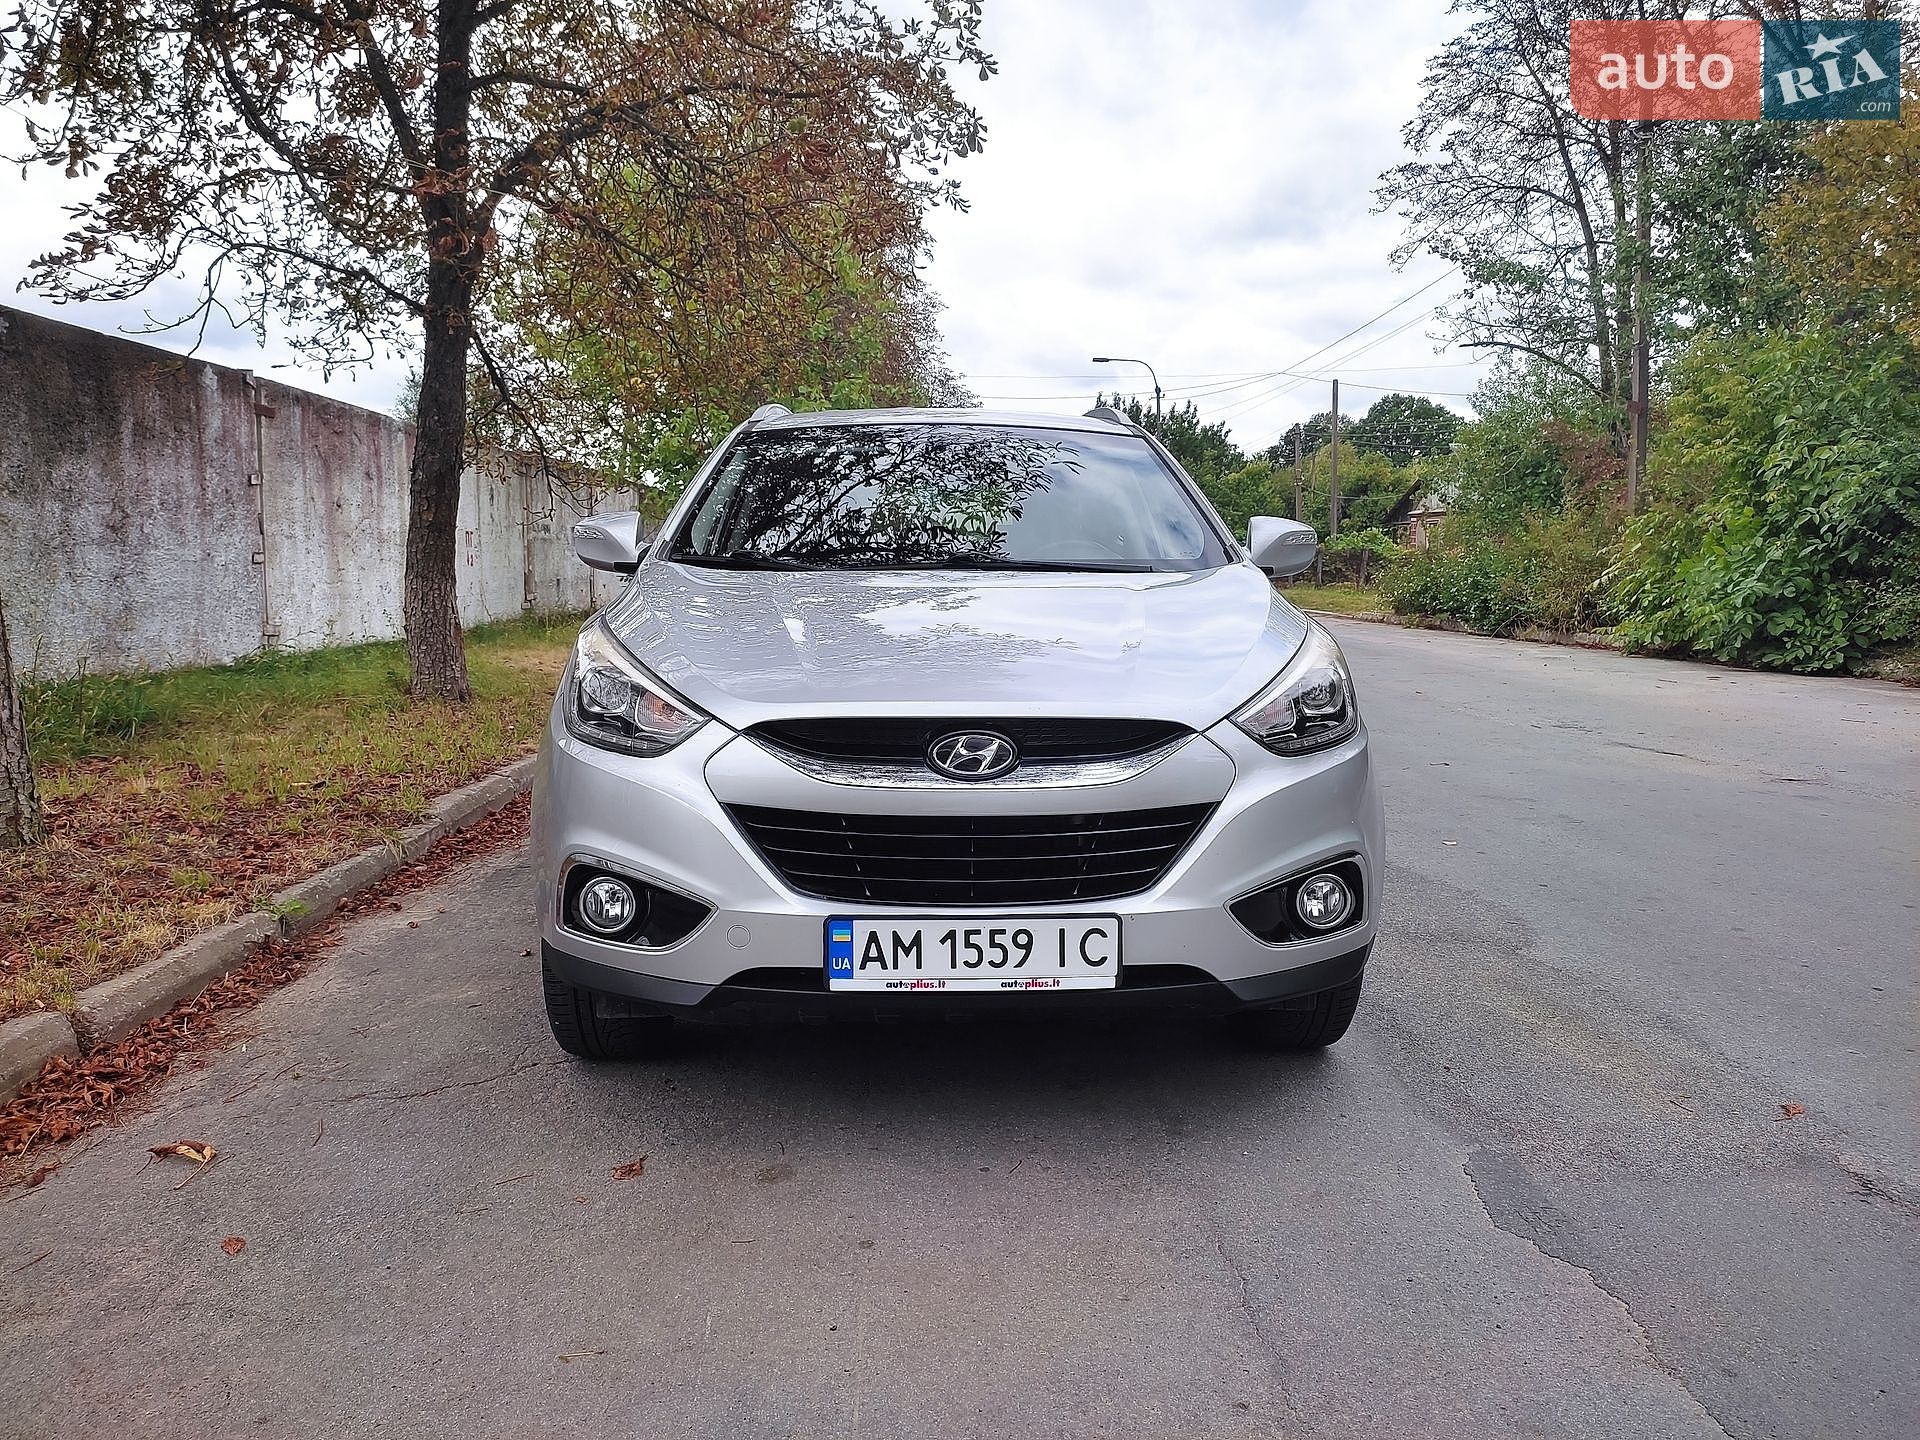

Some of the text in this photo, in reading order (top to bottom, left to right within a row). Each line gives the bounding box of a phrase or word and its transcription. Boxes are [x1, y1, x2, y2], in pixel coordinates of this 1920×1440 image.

[859, 927, 1109, 970] AM 1559 IC
[832, 957, 851, 970] UA
